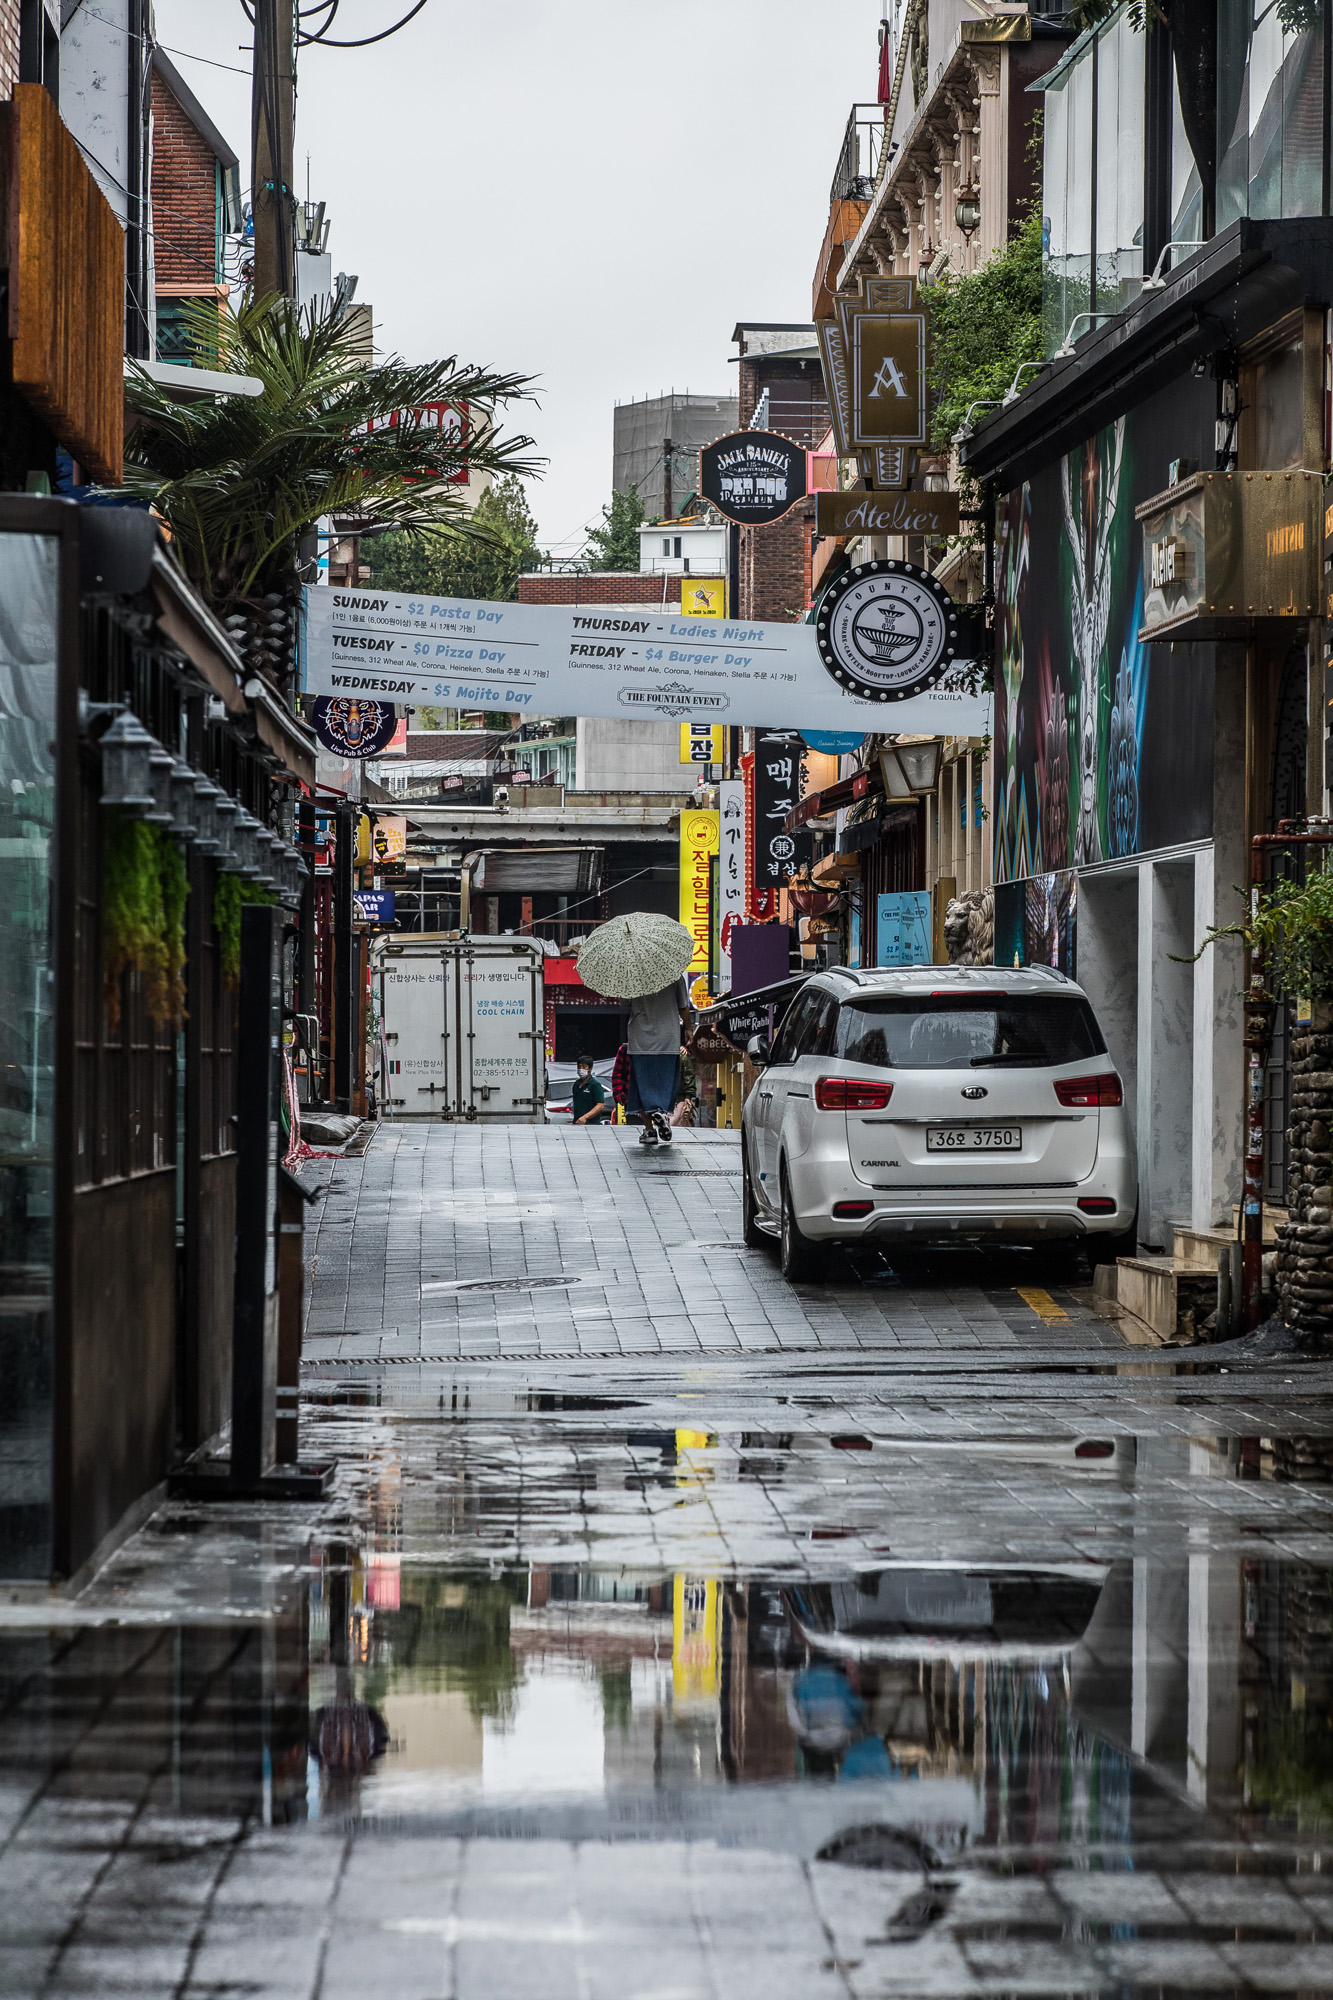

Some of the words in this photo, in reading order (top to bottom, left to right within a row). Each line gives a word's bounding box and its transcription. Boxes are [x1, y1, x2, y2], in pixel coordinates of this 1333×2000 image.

[867, 357, 912, 399] A
[717, 448, 745, 471] JACK
[746, 444, 791, 471] DANIEL'S
[836, 496, 939, 531] Atelier
[332, 595, 390, 612] SUNDAY
[407, 602, 425, 615] $2
[430, 604, 471, 620] Pasta
[476, 608, 504, 624] Day
[844, 582, 937, 628] FOUNTAIN
[413, 620, 428, 629] 주문
[429, 622, 437, 630] 시
[572, 616, 651, 633] THURSDAY
[669, 623, 718, 638] Ladies
[722, 628, 765, 641] Night
[332, 634, 396, 652] TUESDAY
[413, 641, 430, 655] $0
[435, 644, 474, 659] Pizza
[478, 648, 507, 664] Day
[569, 643, 626, 658] FRIDAY
[645, 647, 664, 661] $4
[668, 650, 719, 665] Burger
[723, 653, 753, 667] Day
[368, 656, 382, 664] 312
[383, 657, 404, 667] Wheat
[421, 661, 448, 670] Corona,
[485, 666, 505, 675] Stella
[607, 663, 622, 671] 312
[623, 665, 646, 673] Wheat
[663, 667, 691, 676] Corona,
[731, 671, 751, 679] Stella
[331, 674, 416, 694] WEDNESDAY
[433, 683, 451, 697] $5
[456, 686, 500, 701] Mojito
[505, 690, 533, 705] Day
[626, 692, 645, 701] THE
[646, 693, 691, 704] FOUNTAIN
[692, 696, 722, 706] EVENT
[928, 693, 963, 701] TEQUILA
[330, 744, 344, 754] Live
[343, 749, 357, 757] Pub
[362, 744, 376, 754] Club
[477, 1008, 498, 1016] COOL
[500, 1008, 525, 1016] CHAIN
[729, 1017, 751, 1031] White
[965, 1088, 985, 1097] KIA
[936, 1132, 966, 1146] 36호
[973, 1130, 1012, 1146] 3750
